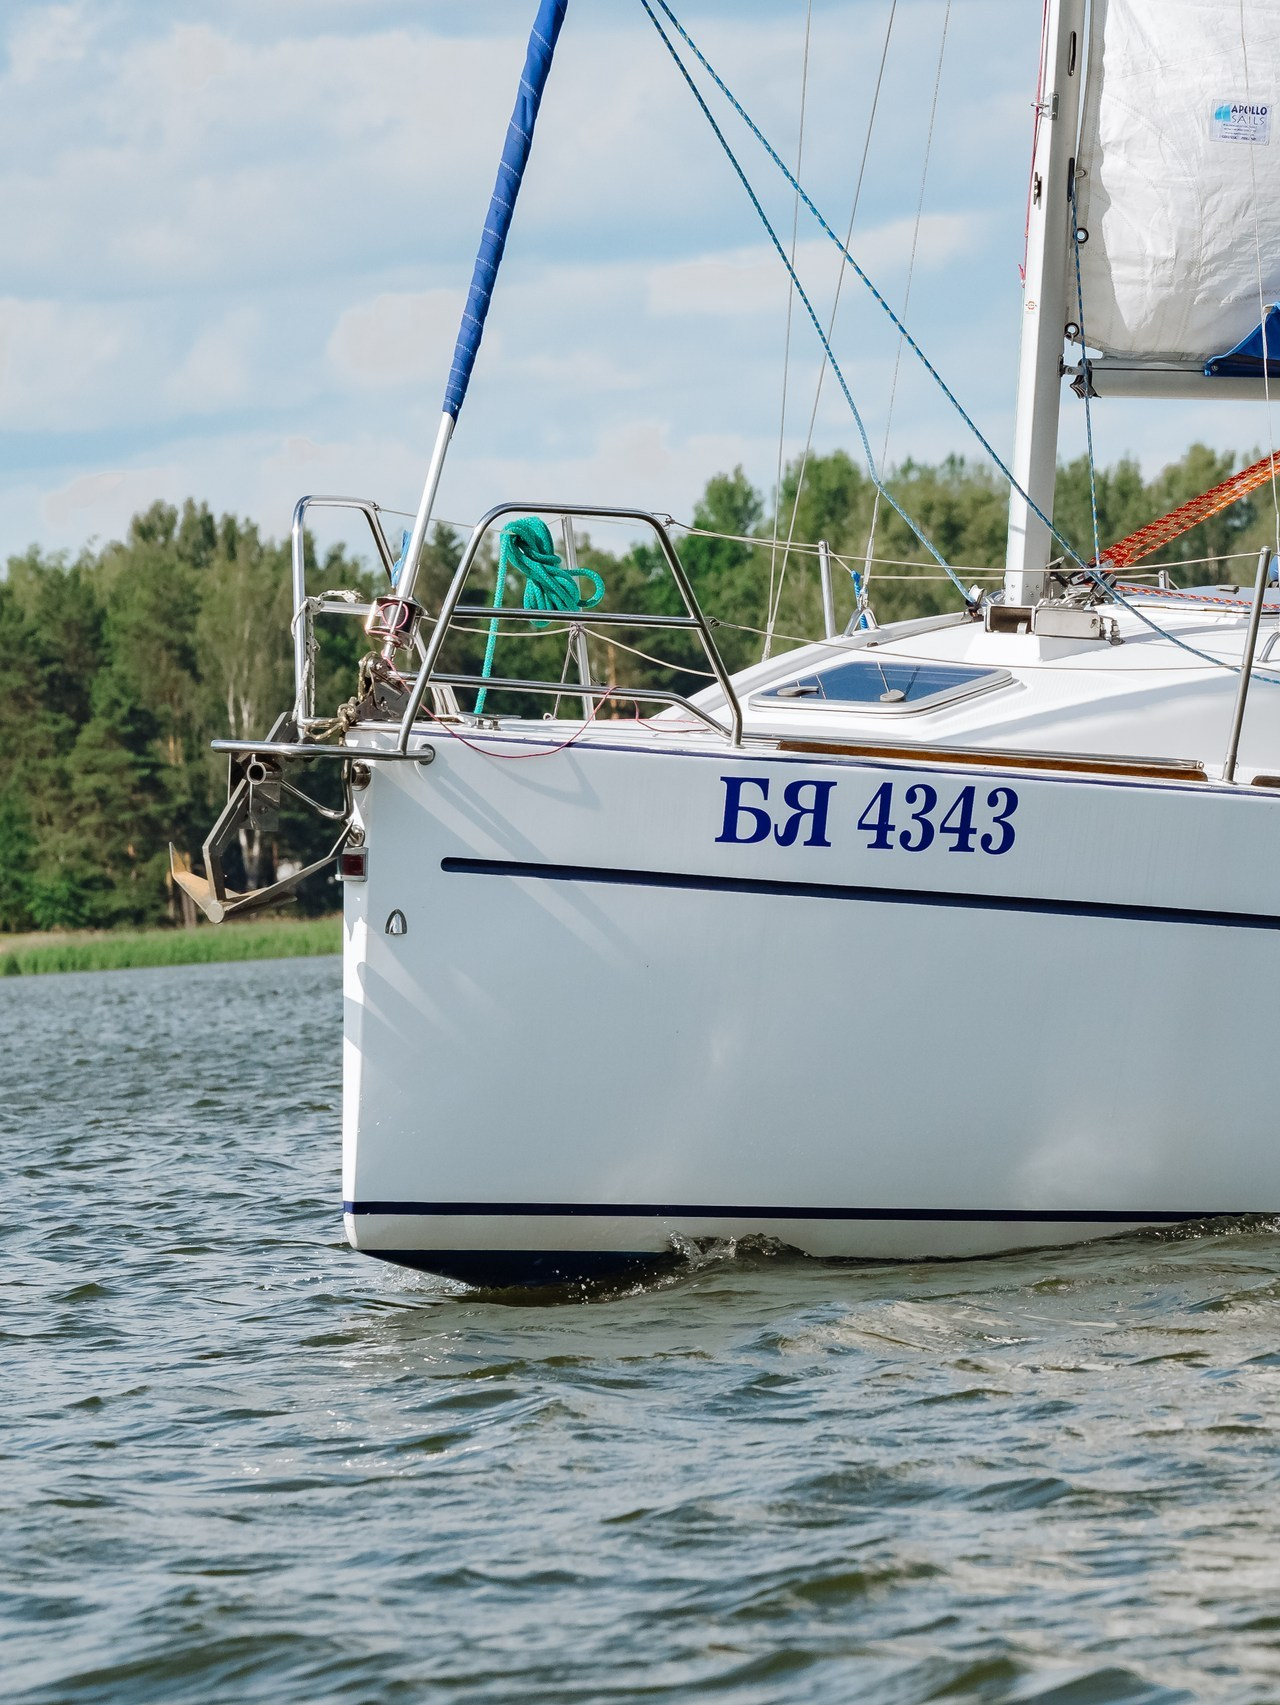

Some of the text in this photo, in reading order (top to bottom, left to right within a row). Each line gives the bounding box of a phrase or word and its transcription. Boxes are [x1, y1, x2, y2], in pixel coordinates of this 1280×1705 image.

[1231, 104, 1268, 116] APOLLO
[1231, 115, 1265, 126] SAILS
[714, 776, 1020, 856] БЯ 4343
